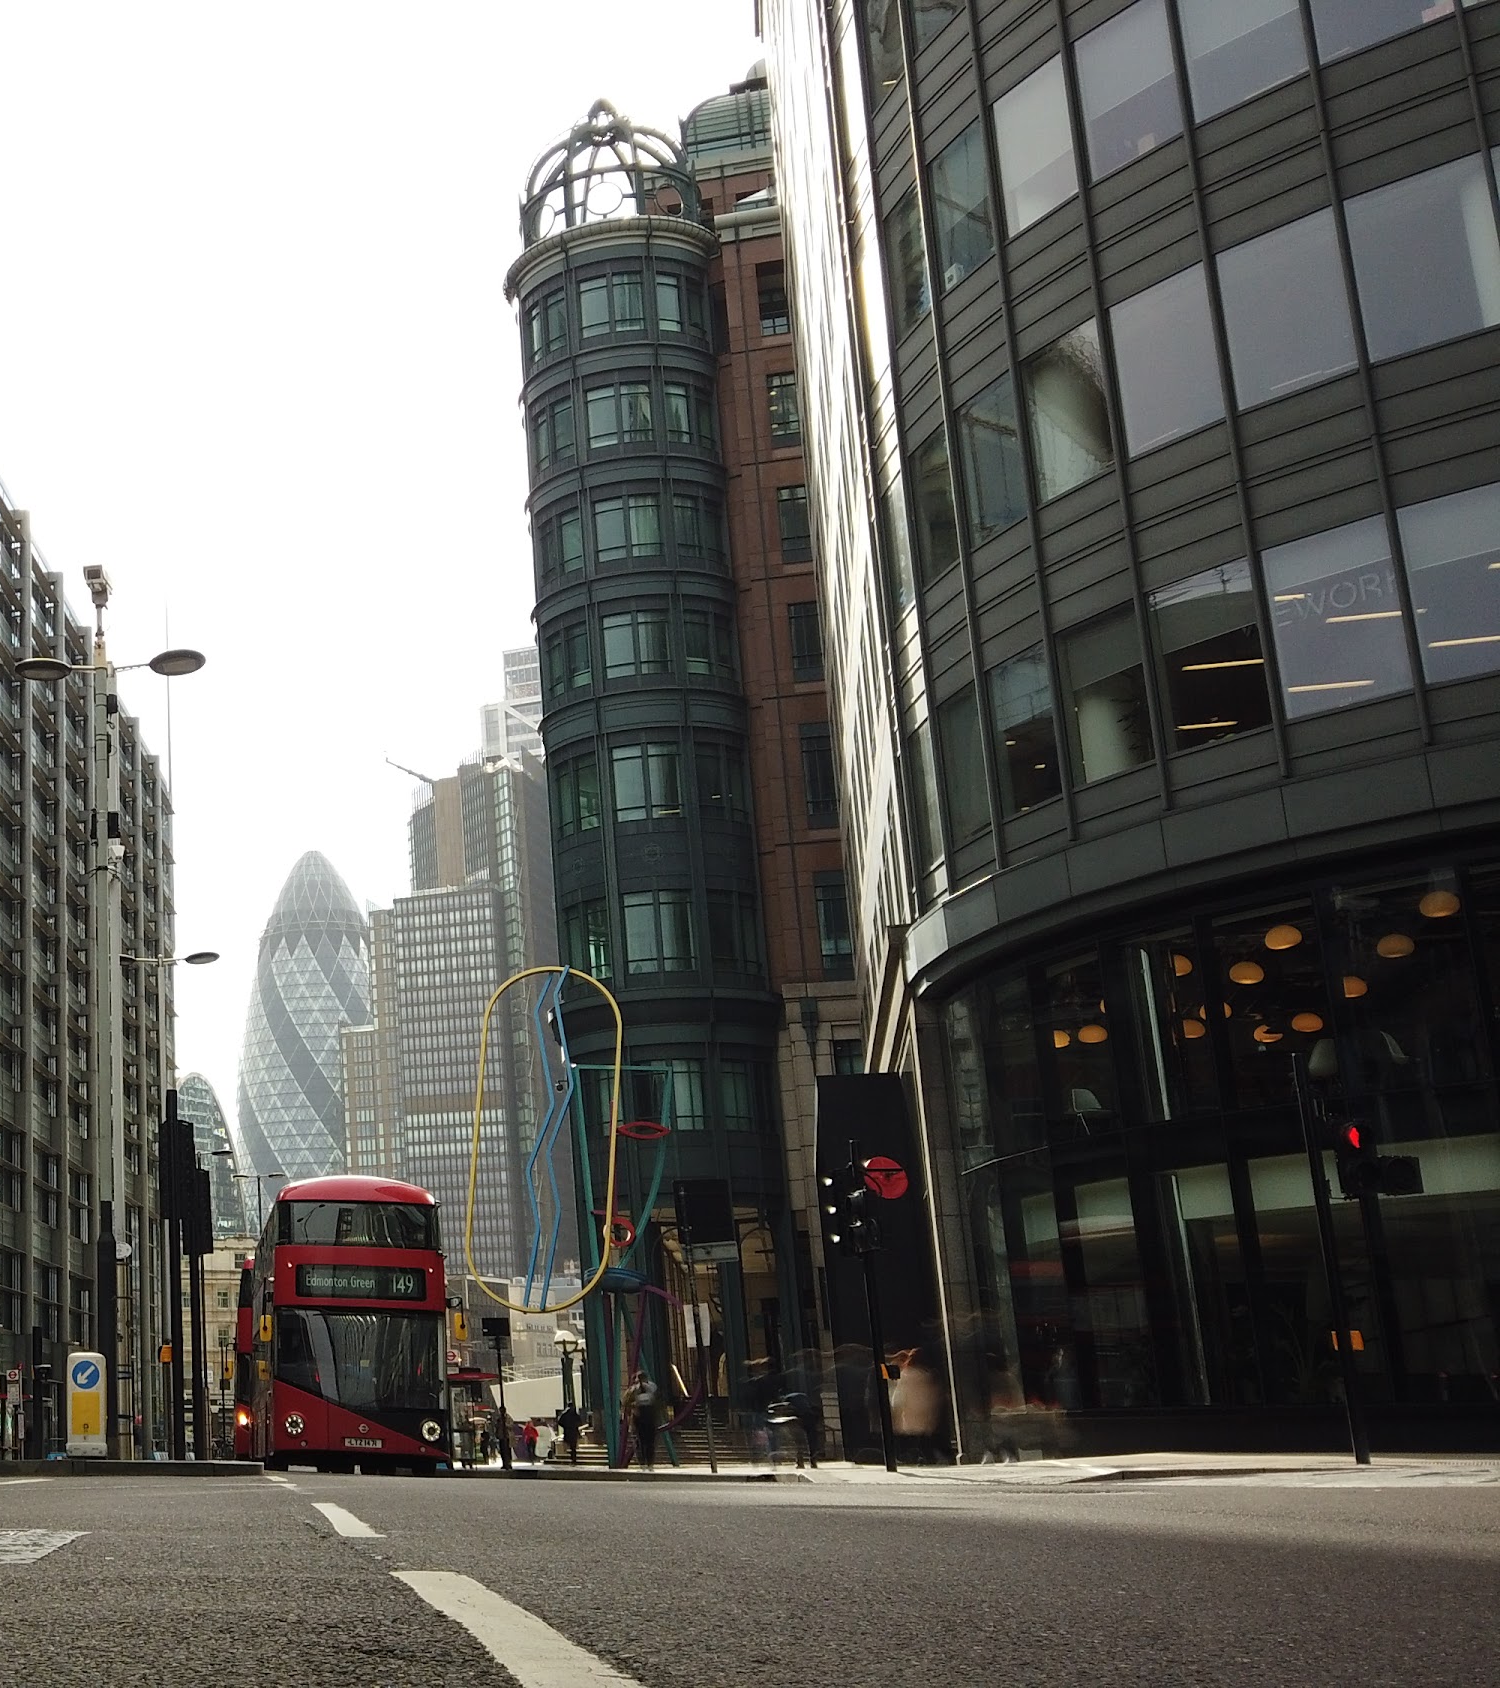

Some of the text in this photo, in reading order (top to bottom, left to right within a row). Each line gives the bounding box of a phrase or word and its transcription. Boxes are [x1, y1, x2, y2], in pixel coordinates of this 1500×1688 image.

[306, 1273, 414, 1294] Edmonton Green 149
